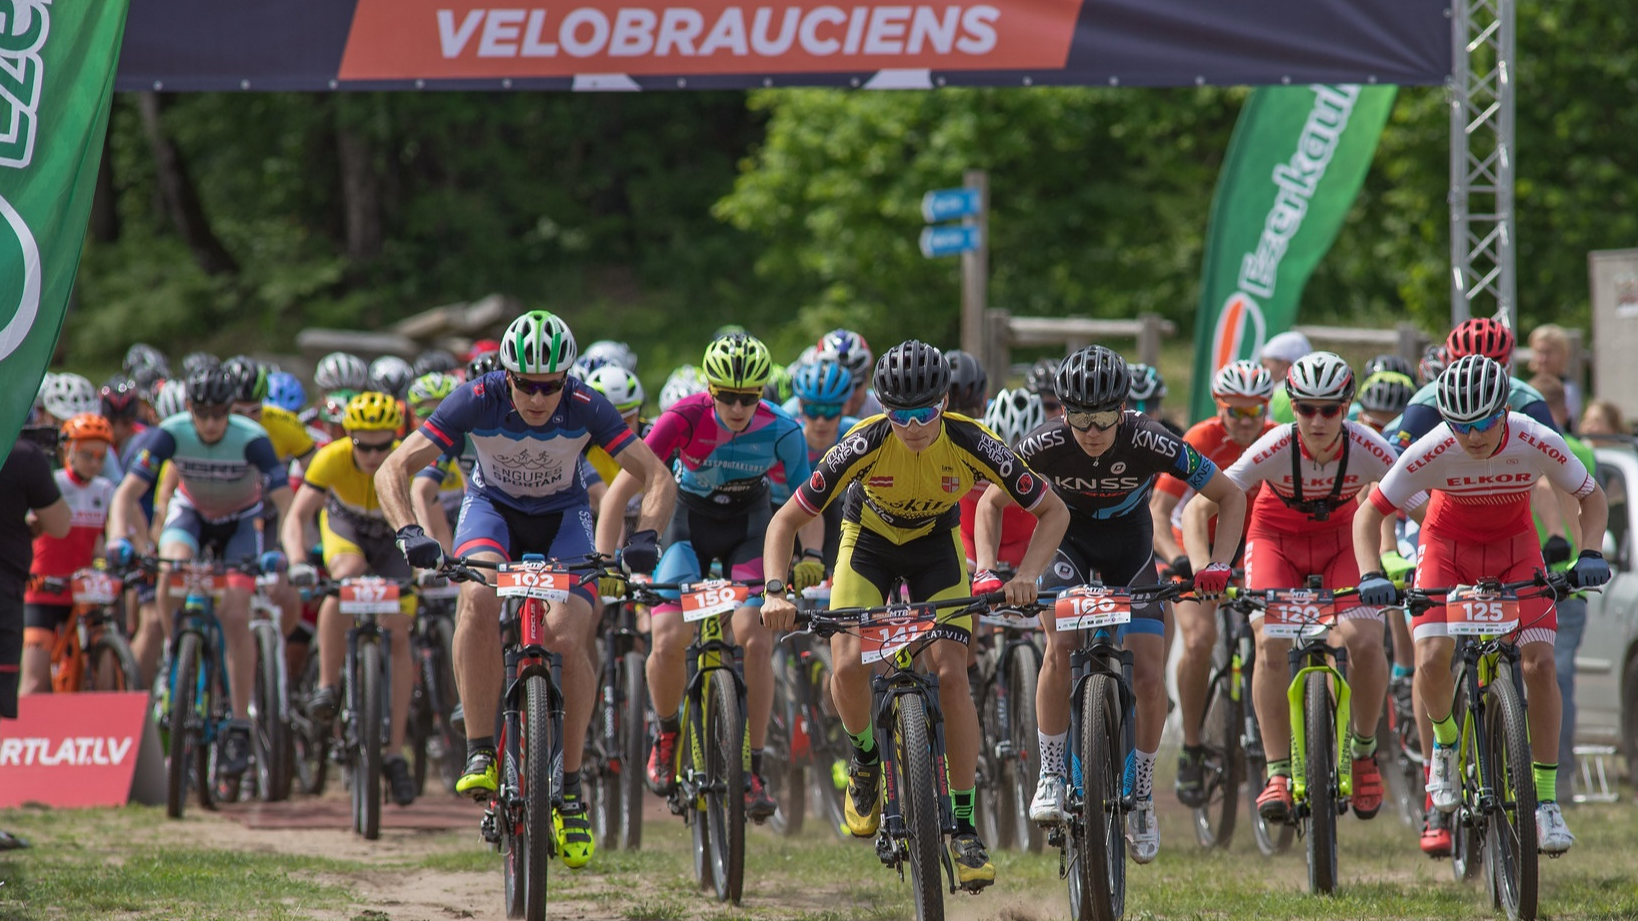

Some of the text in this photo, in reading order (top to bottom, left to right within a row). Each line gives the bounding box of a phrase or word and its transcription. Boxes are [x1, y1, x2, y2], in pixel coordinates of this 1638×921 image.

[437, 5, 1000, 58] VELOBRAUCIENS
[1350, 431, 1393, 466] ELKOR
[1406, 437, 1456, 474] ELKOR
[1518, 431, 1568, 465] ELKOR
[492, 463, 562, 482] ENGURES
[1446, 472, 1532, 487] ELKOR
[511, 573, 554, 588] 102
[694, 587, 736, 608] 150
[1070, 598, 1115, 615] 160
[1278, 605, 1320, 623] 120
[1462, 602, 1504, 621] 125
[879, 625, 918, 647] 141
[0, 737, 133, 766] RTLAT.LV
